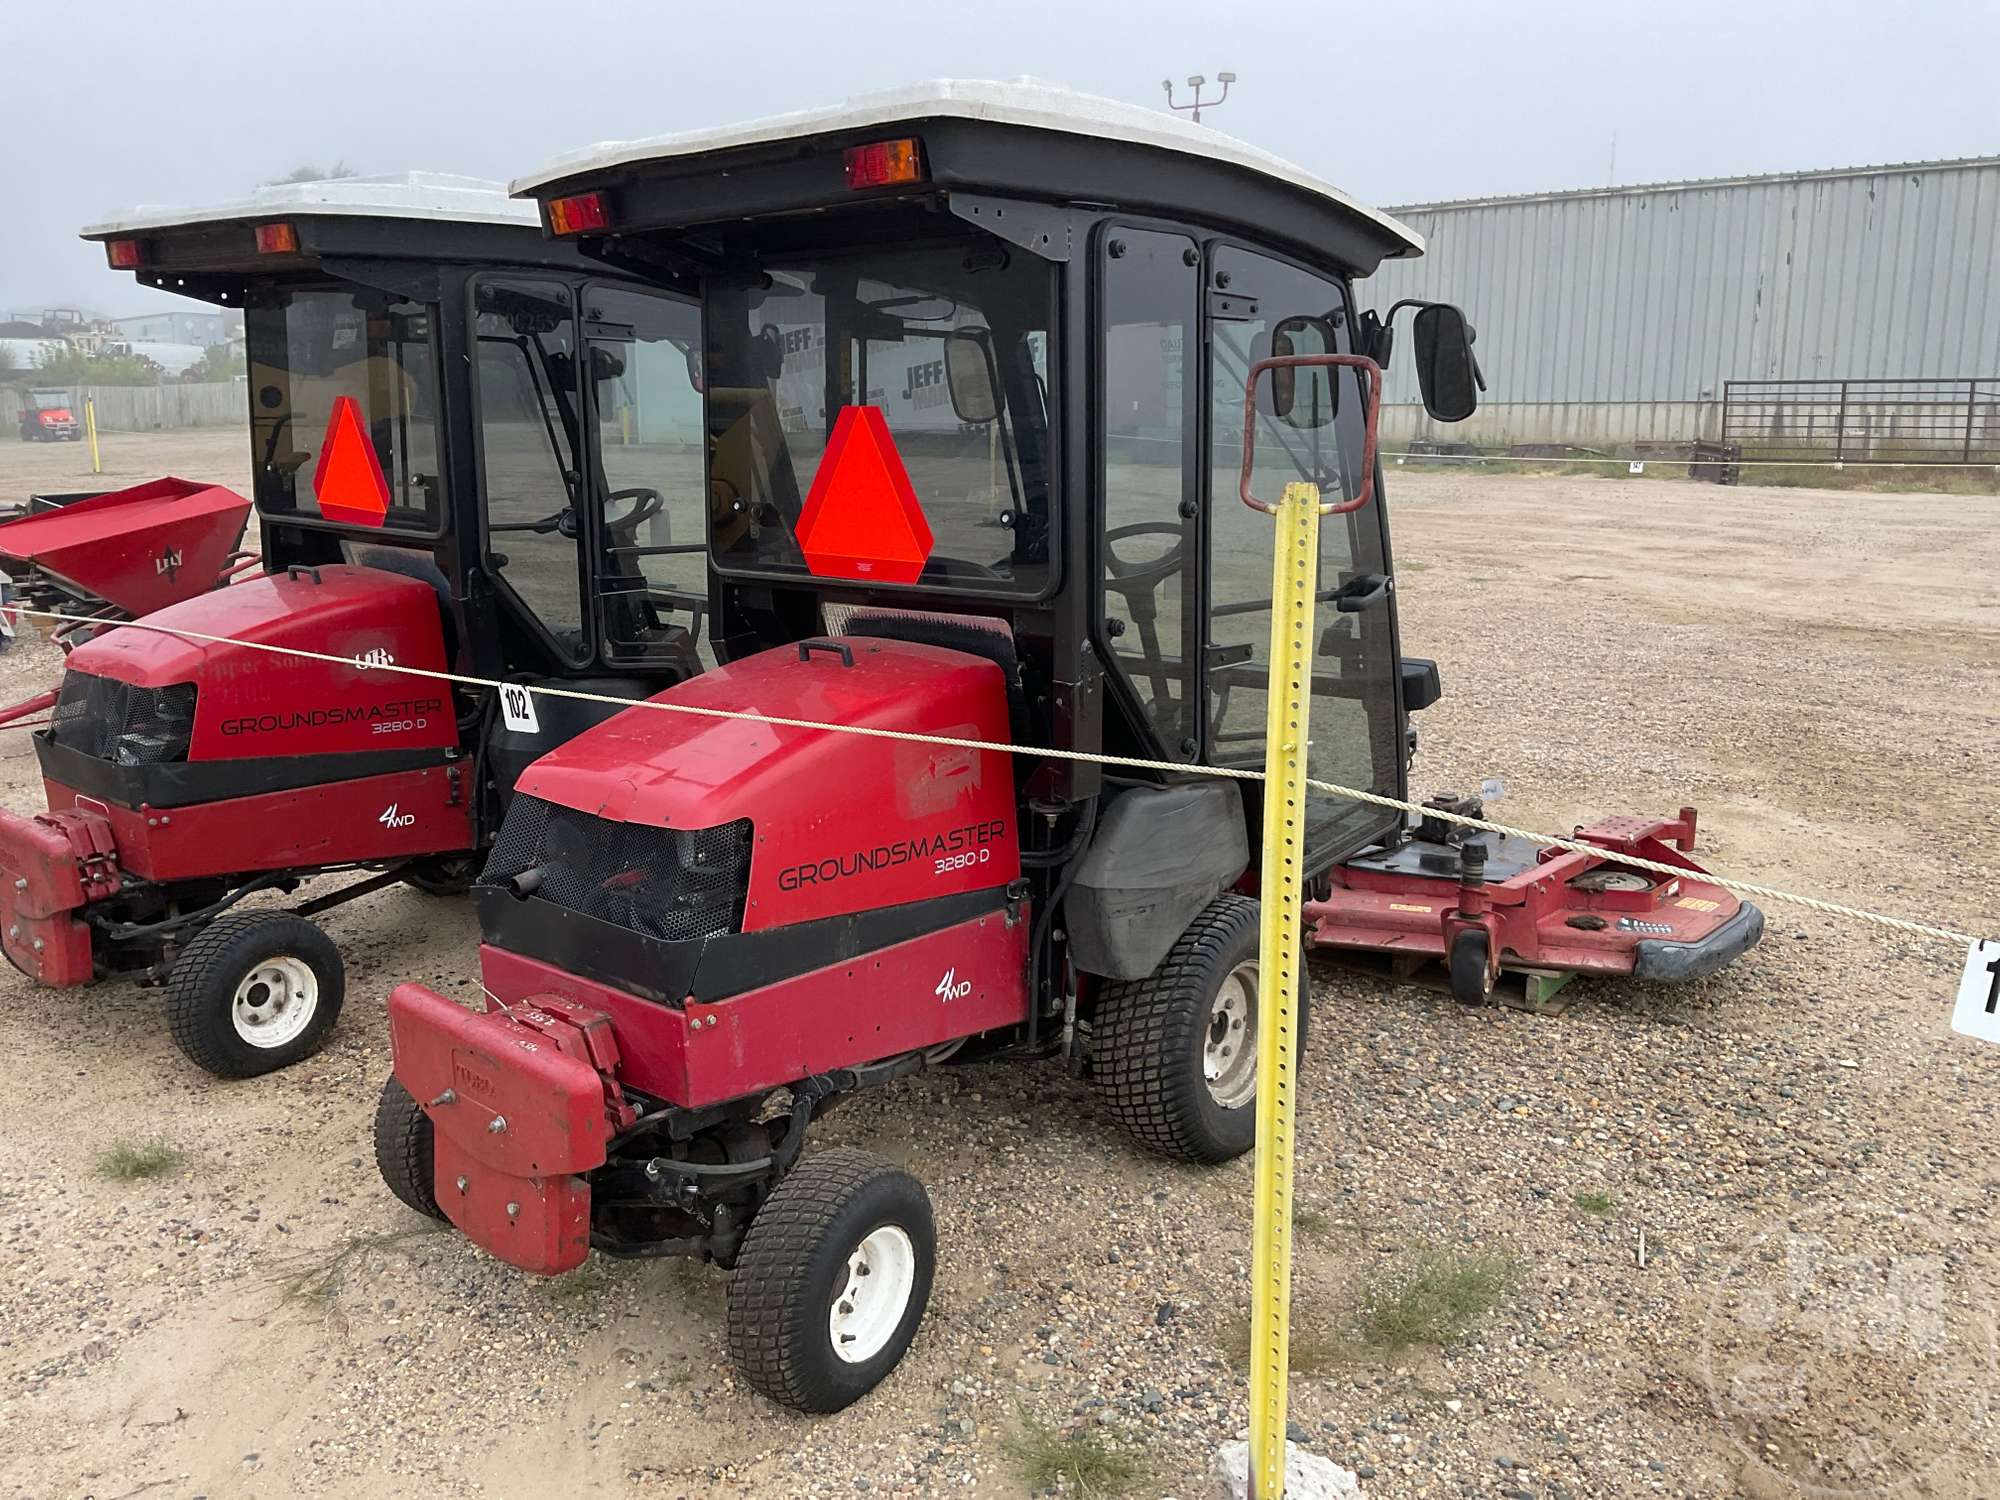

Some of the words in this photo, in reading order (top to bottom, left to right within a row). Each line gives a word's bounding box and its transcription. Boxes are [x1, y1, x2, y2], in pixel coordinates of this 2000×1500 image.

[902, 360, 943, 400] JEFF
[220, 698, 443, 736] GROUNDSMASTER
[505, 688, 530, 720] 102
[379, 802, 415, 829] 4WD
[778, 819, 1005, 891] GROUNDSMASTER
[935, 967, 971, 1003] 4WD
